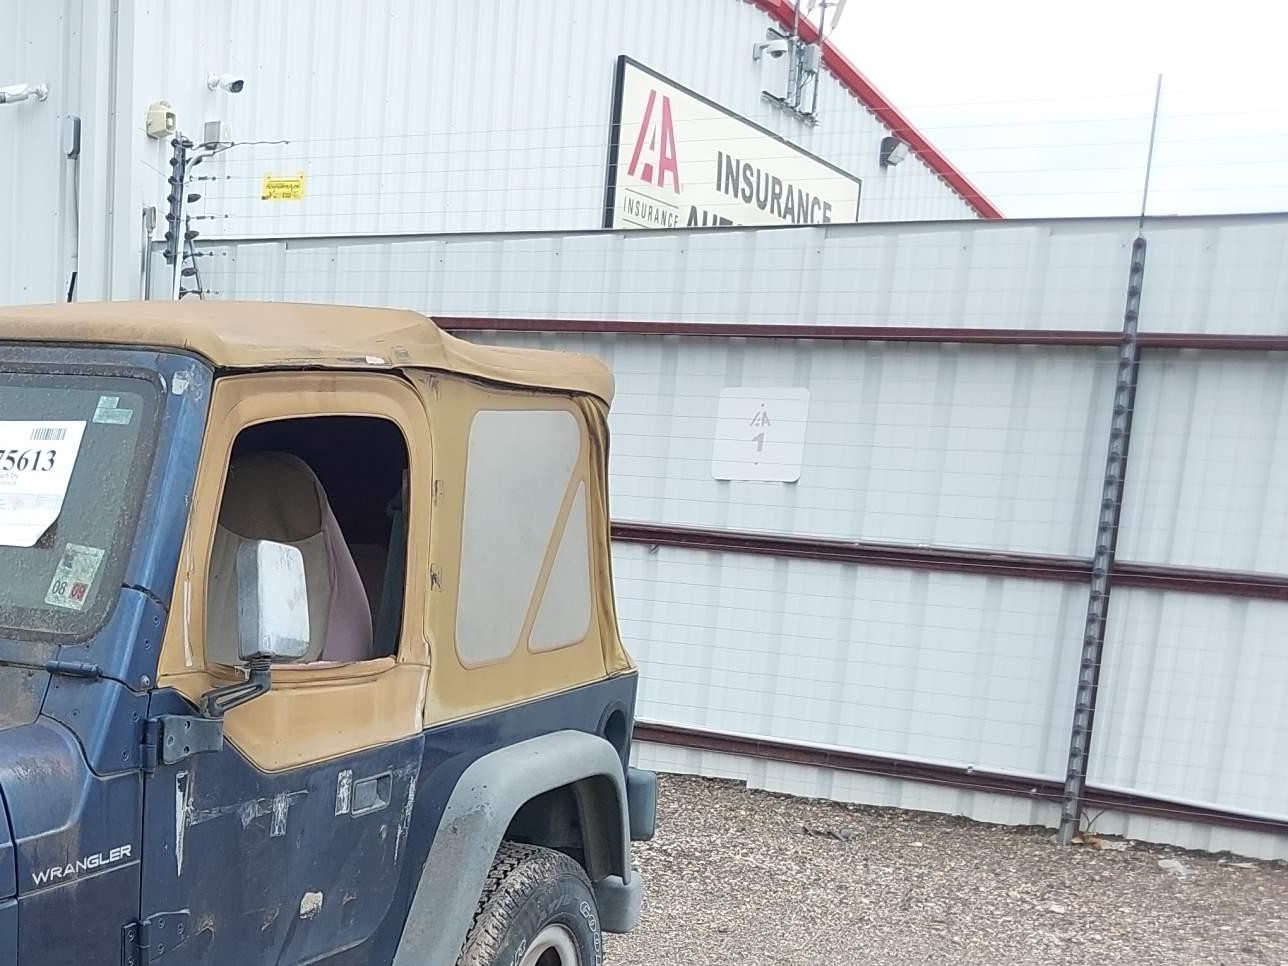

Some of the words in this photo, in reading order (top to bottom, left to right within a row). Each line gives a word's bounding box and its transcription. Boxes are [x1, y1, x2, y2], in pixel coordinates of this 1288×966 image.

[715, 150, 832, 224] INSURANCE
[623, 195, 679, 228] INSURANCE
[752, 432, 765, 453] 1
[52, 580, 68, 595] 08
[31, 844, 132, 886] WRANGLER
